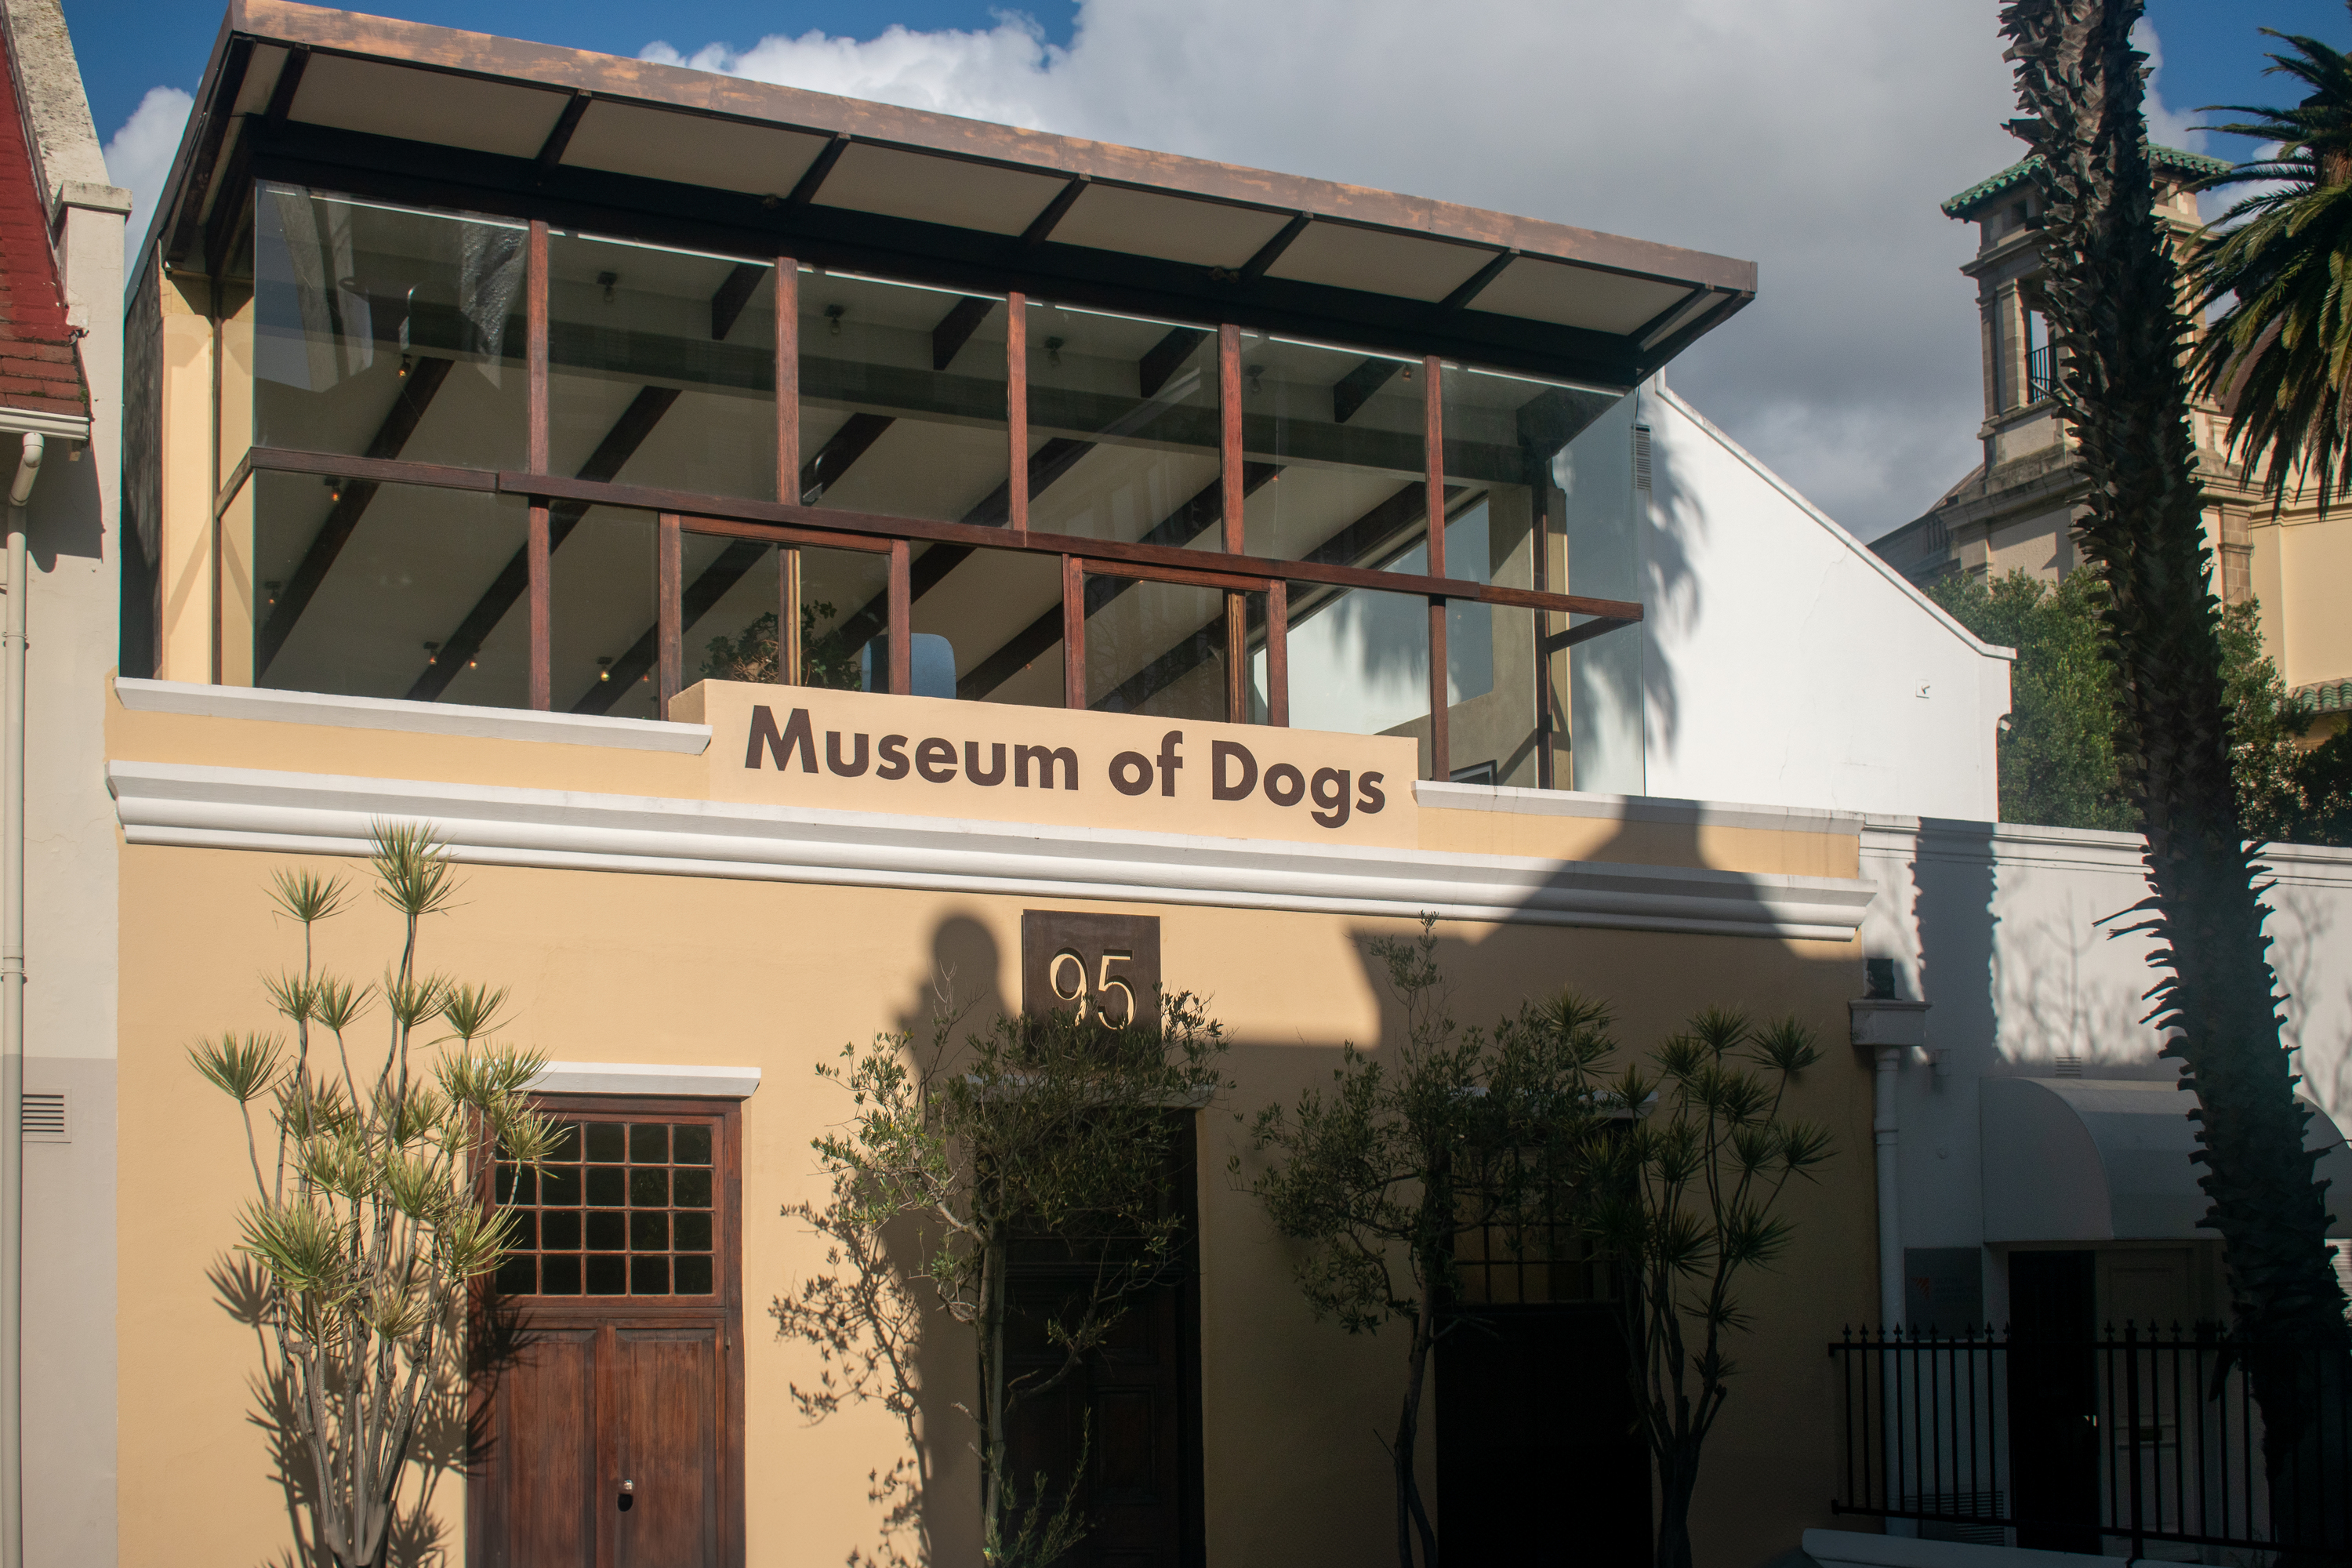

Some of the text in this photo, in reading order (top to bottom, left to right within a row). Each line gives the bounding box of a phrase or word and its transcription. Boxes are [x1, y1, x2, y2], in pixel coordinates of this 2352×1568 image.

[744, 704, 1386, 829] Museum of Dogs
[1049, 946, 1137, 1031] 95
